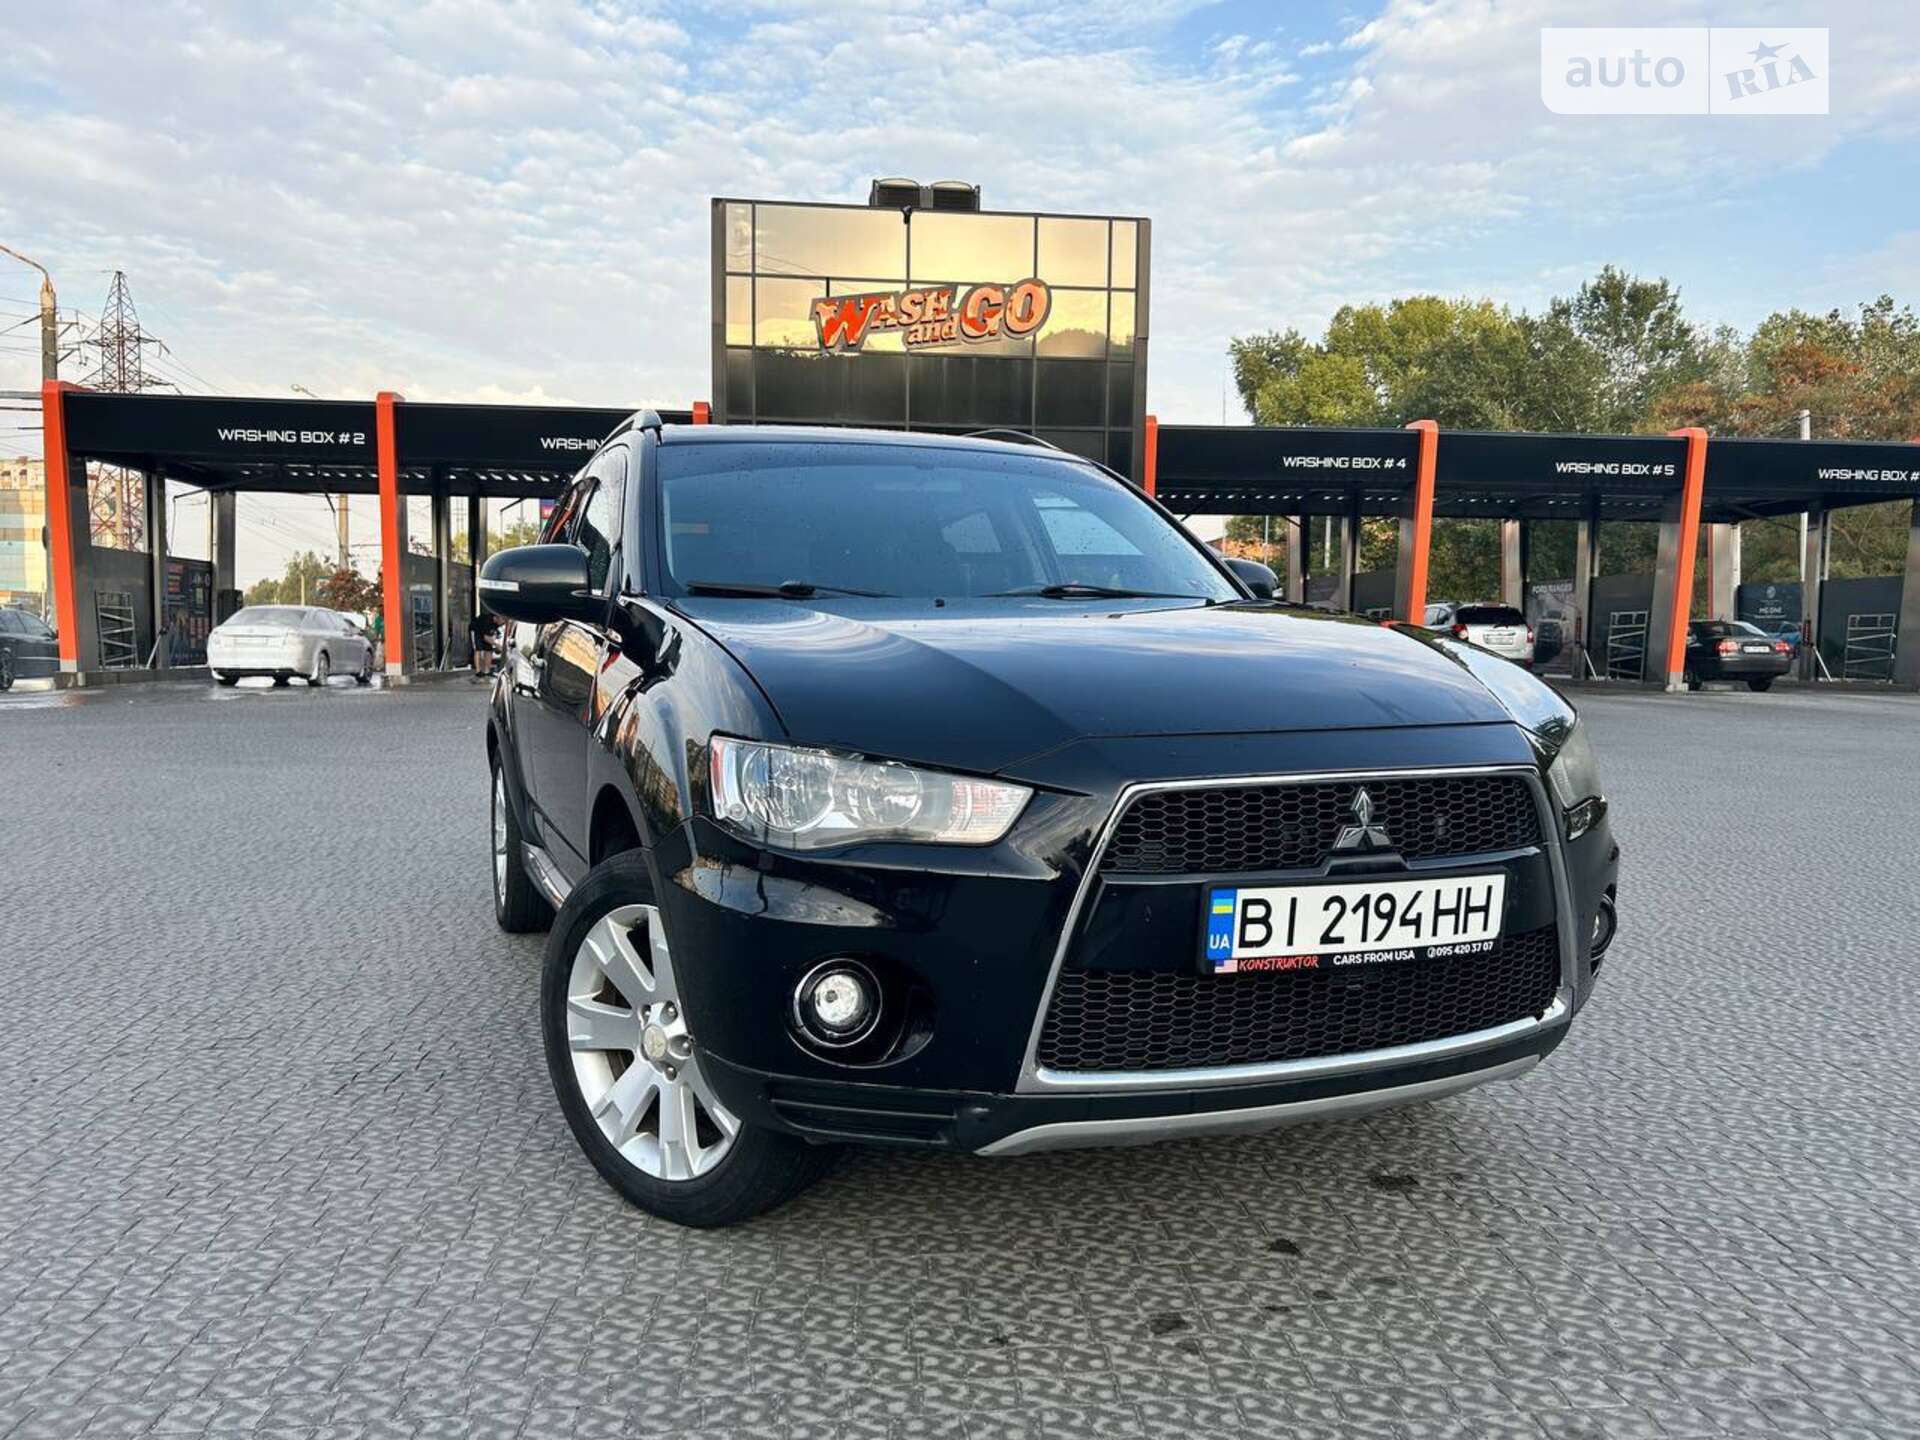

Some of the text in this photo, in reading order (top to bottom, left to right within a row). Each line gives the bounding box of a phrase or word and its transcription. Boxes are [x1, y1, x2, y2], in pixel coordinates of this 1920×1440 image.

[815, 281, 1050, 348] WASH and GO
[217, 428, 297, 443] WASHING
[300, 431, 335, 444] BOX
[540, 437, 605, 450] WASHIN
[1282, 456, 1350, 468] WASHING
[1352, 457, 1382, 469] BOX
[1555, 462, 1620, 474] WASHING
[1621, 463, 1650, 475] BOX
[1818, 468, 1879, 480] WASHING
[1880, 470, 1909, 481] BOX
[1238, 896, 1298, 949] BI
[1209, 934, 1230, 949] UA
[1238, 955, 1320, 971] KONSTRUKTOR
[1333, 953, 1363, 965] CARS
[1363, 952, 1394, 964] FROM
[1394, 950, 1416, 961] USA
